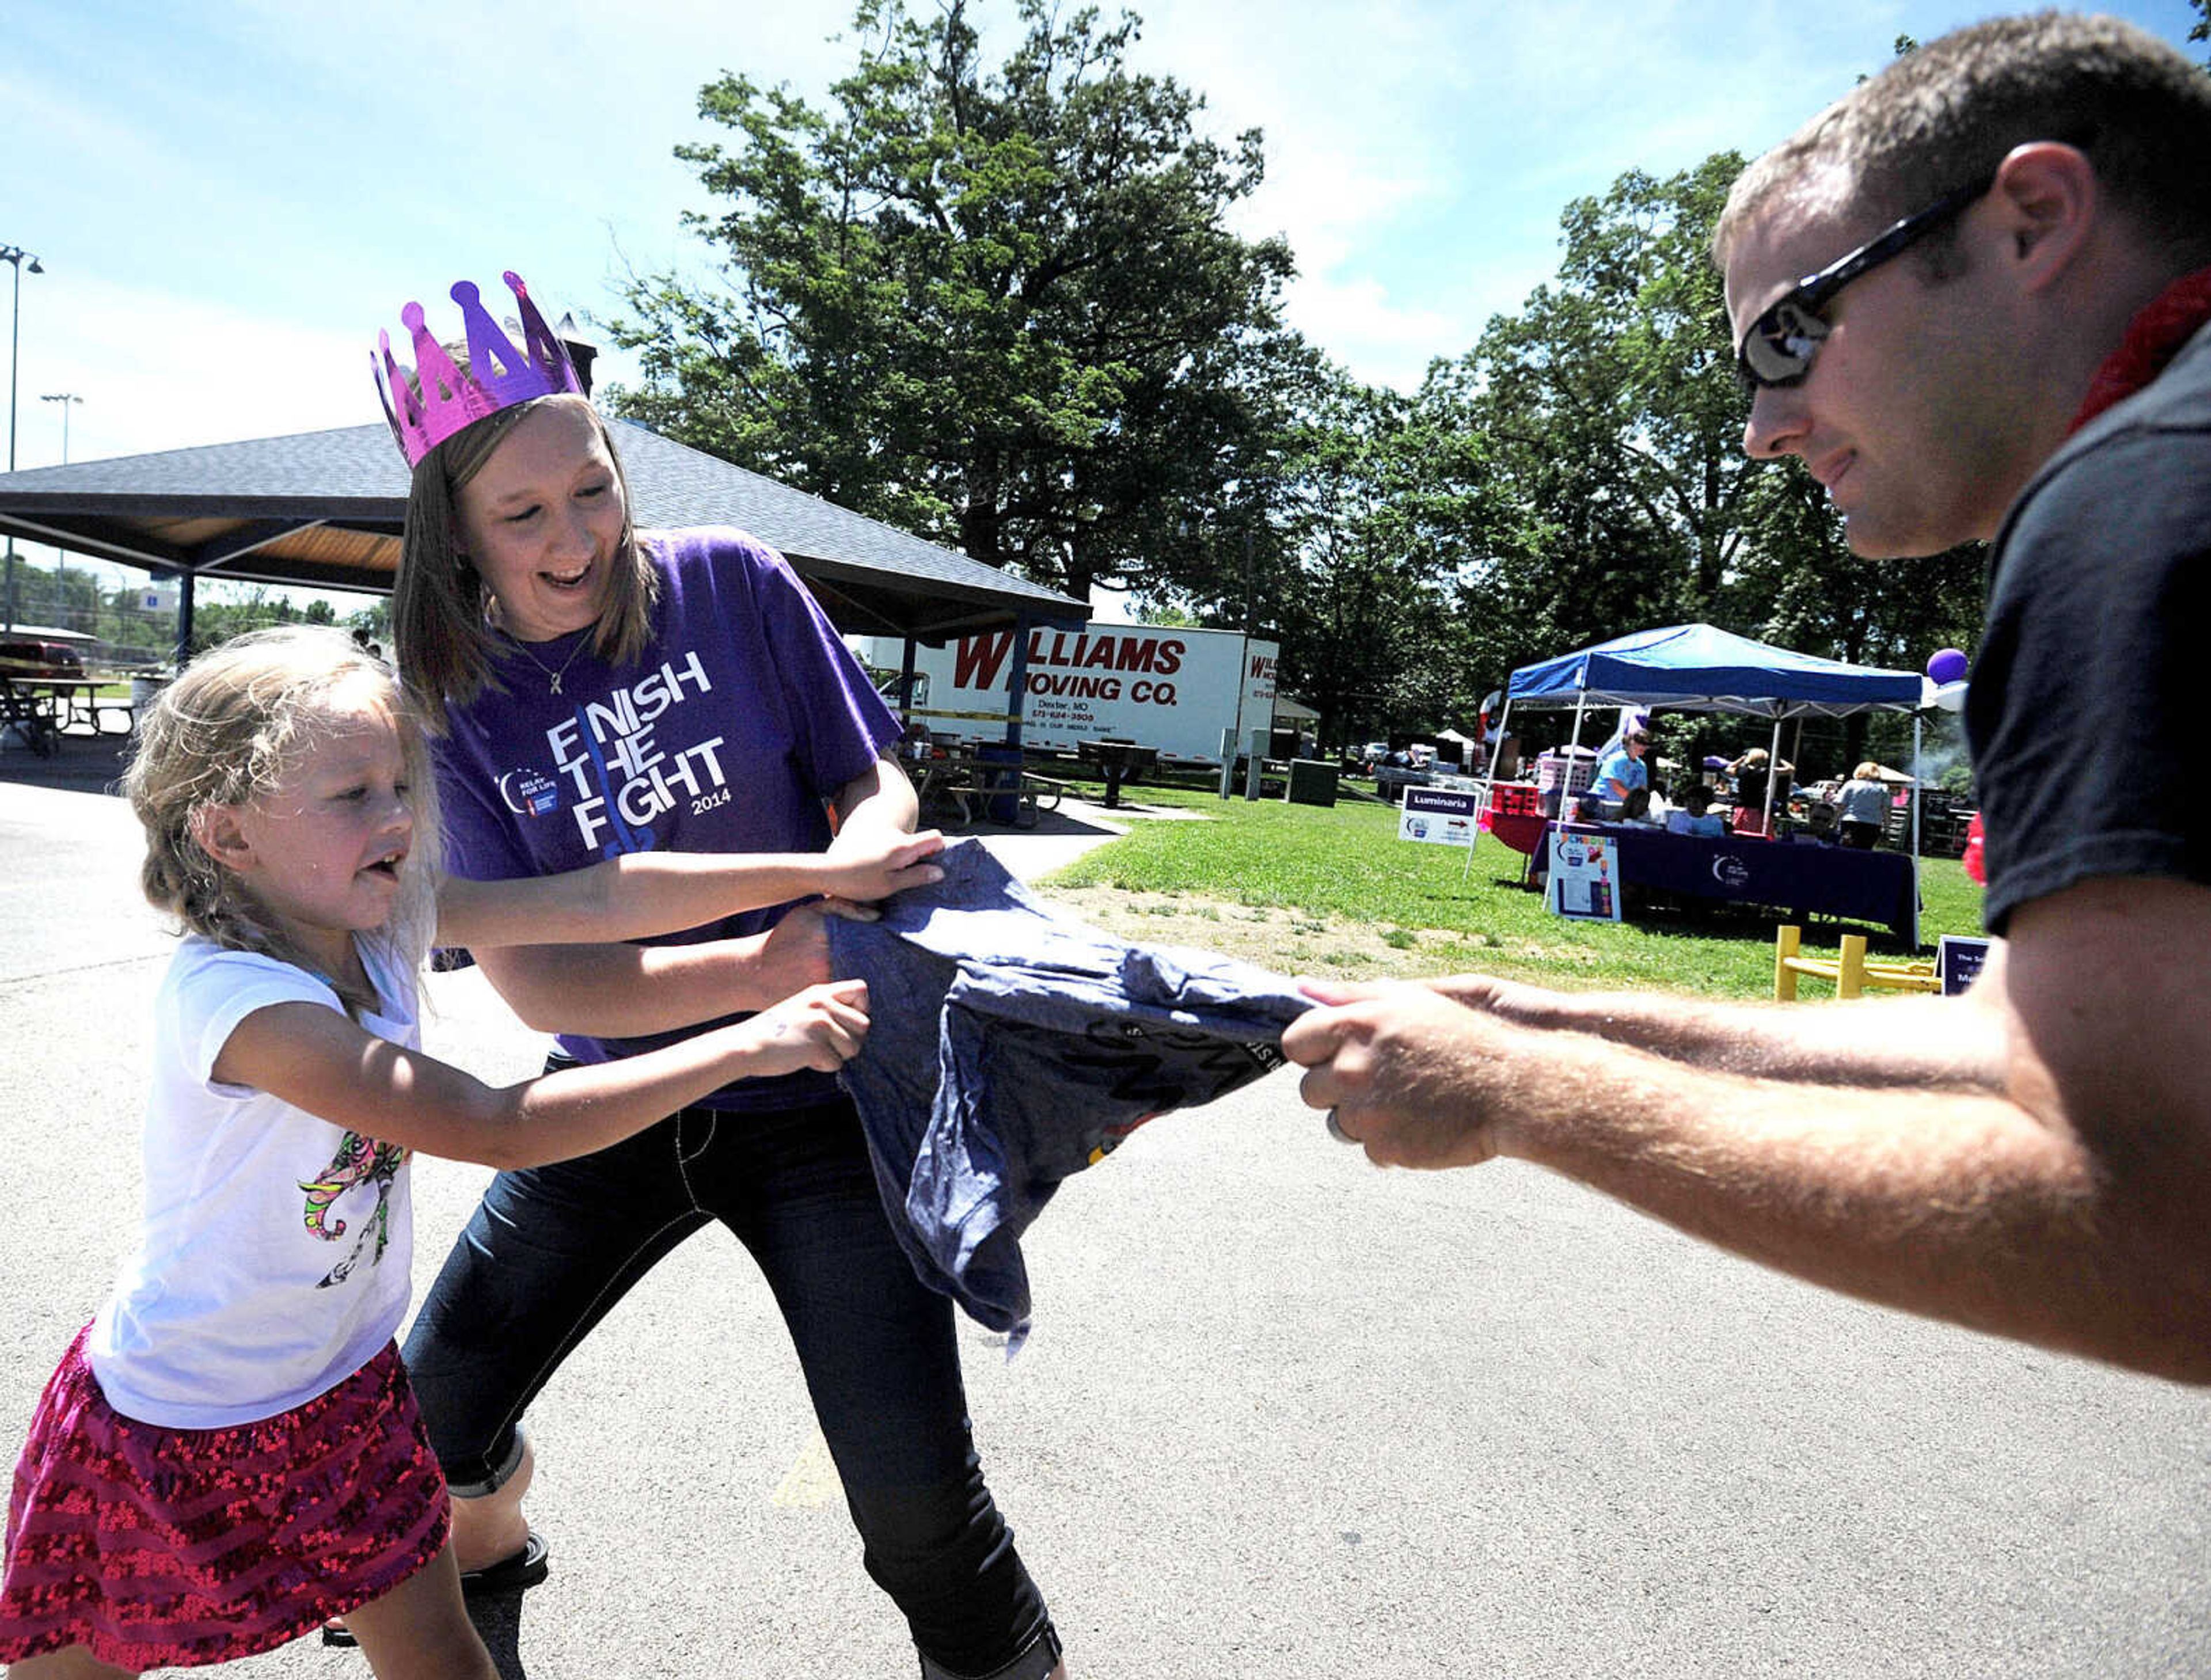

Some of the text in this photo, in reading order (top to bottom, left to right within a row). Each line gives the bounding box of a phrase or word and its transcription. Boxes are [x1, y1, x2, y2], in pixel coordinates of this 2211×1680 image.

[953, 631, 1186, 691] WLLIAMS
[1131, 680, 1177, 706] CO.
[1073, 702, 1088, 712] MO
[559, 723, 666, 801] THE
[522, 781, 557, 796] FOR LIFE
[691, 788, 732, 815] 2014
[1414, 796, 1467, 808] Luminaria
